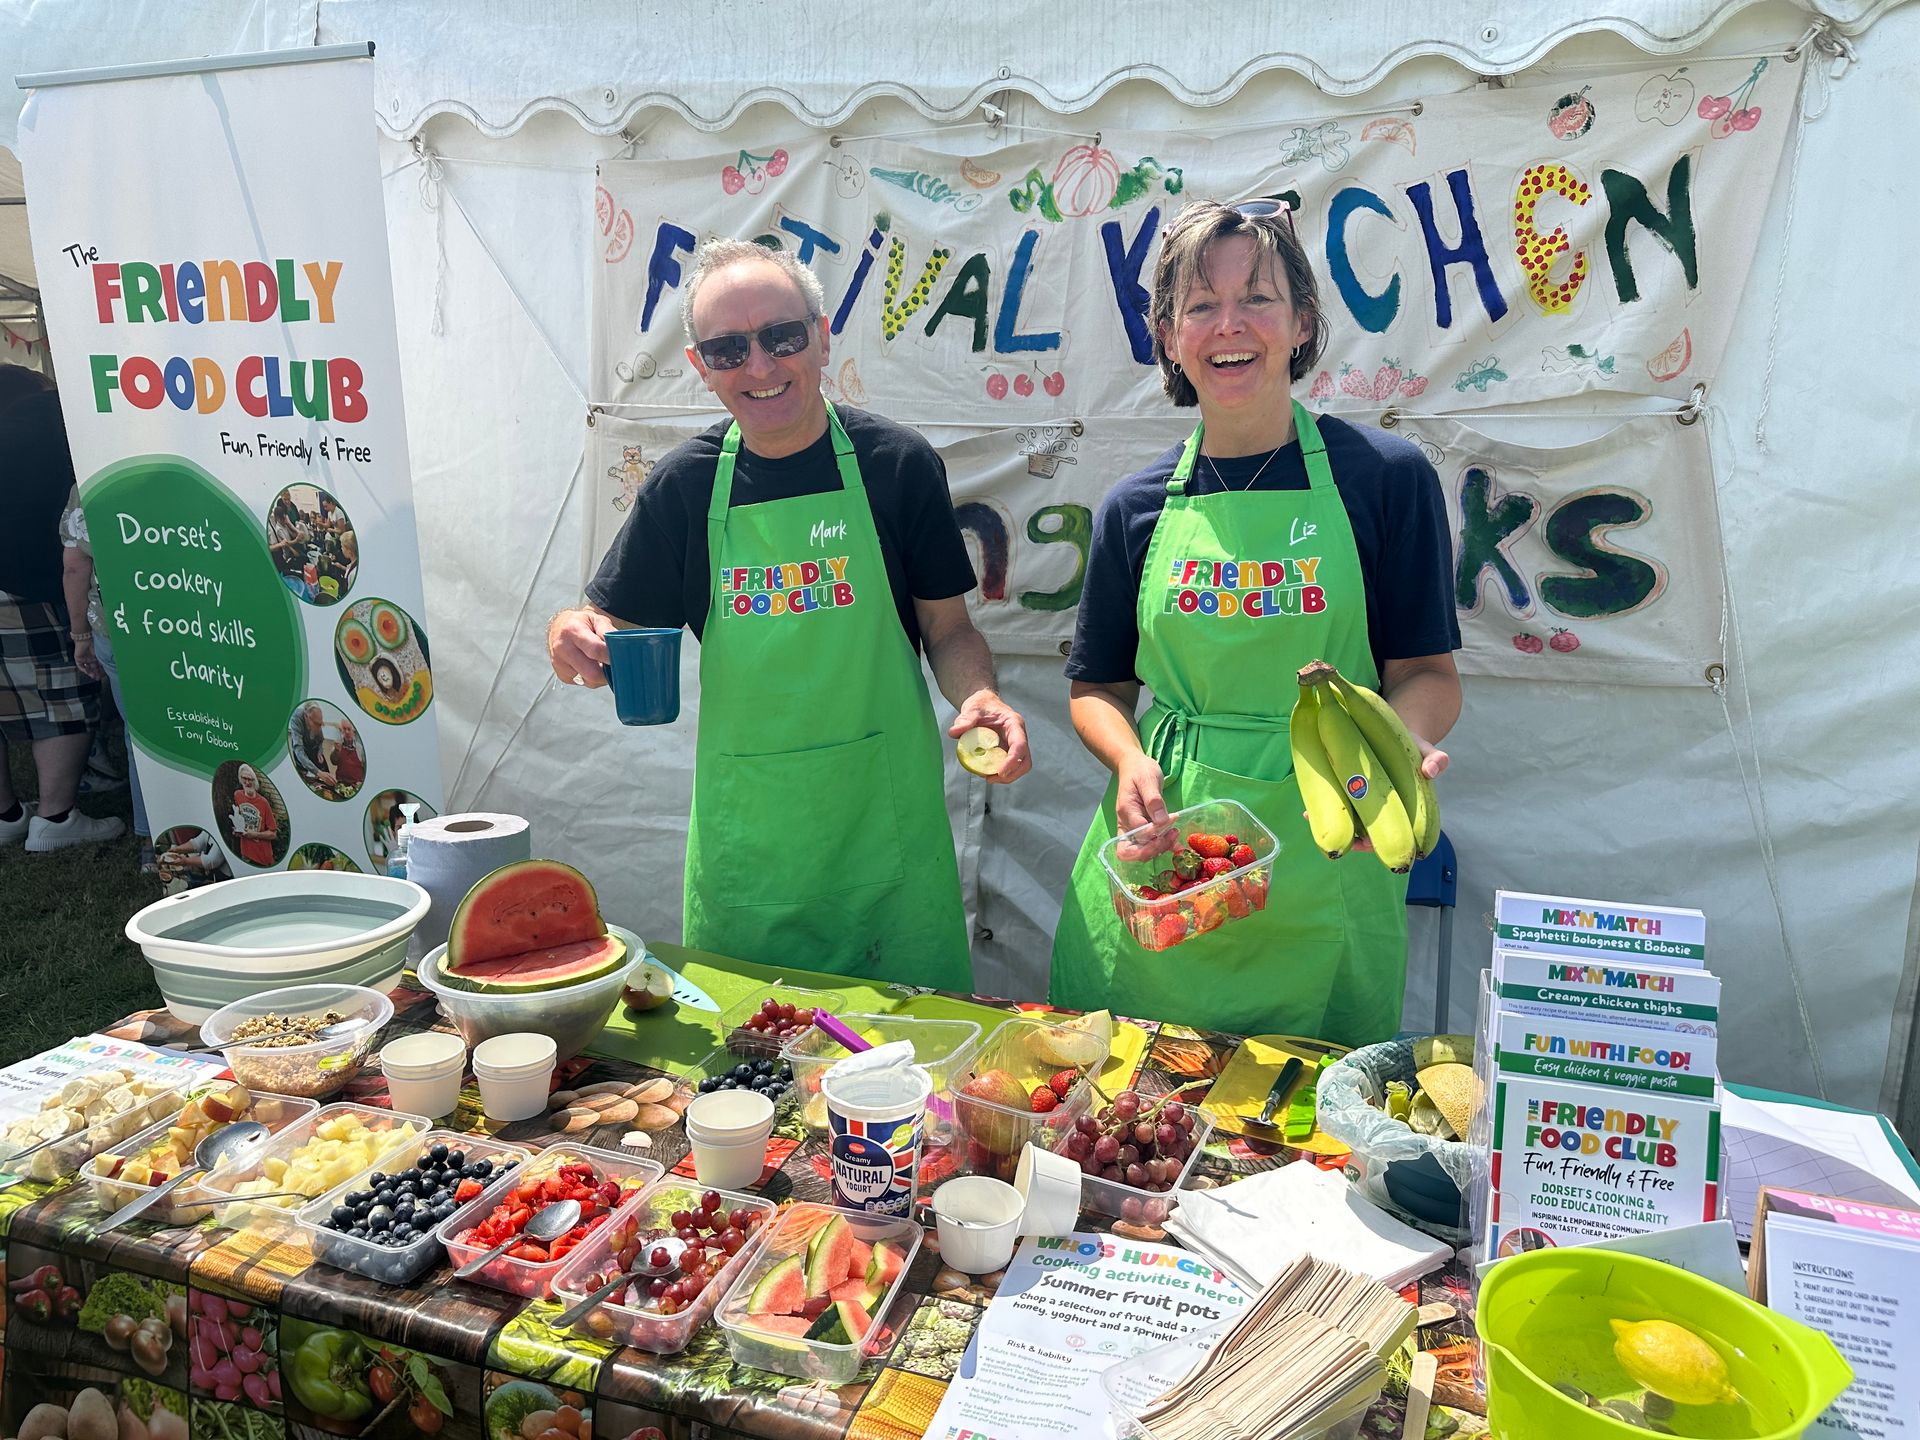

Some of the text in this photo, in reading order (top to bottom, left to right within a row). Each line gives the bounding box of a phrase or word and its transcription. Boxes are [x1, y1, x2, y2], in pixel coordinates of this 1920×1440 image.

[62, 242, 99, 268] The
[1100, 152, 1698, 365] KCHEN
[89, 354, 226, 415] FOOD
[220, 431, 372, 465] Fun, Friendly & Free
[116, 512, 222, 551] Dorset's
[810, 519, 847, 548] Mark
[1289, 517, 1317, 546] Liz
[134, 568, 223, 607] cookery
[721, 568, 731, 593] THE
[1168, 560, 1183, 586] THE
[722, 592, 787, 619] FOOD
[1163, 588, 1239, 617] FOOD
[113, 603, 257, 648] & food skills
[170, 651, 244, 699] charity
[166, 707, 233, 735] Established by
[174, 726, 240, 751] Tony Gibbons
[1512, 927, 1691, 956] Spaghetti bolognese & Bobotie
[1537, 989, 1683, 1016] Creamy chicken thighs
[1569, 1039, 1625, 1062] WITH
[1627, 1045, 1691, 1071] FOOD!
[1534, 1058, 1678, 1089] Easy chicken & veggie pasta
[1527, 1098, 1539, 1122] THE
[1525, 1124, 1600, 1155] FOOD
[835, 1160, 887, 1184] NATURAL
[844, 1152, 871, 1166] Creamy
[845, 1181, 872, 1193] YOGURT
[1559, 1157, 1622, 1189] Friendly
[1626, 1170, 1635, 1188] &
[1638, 1169, 1675, 1192] Free
[1530, 1194, 1669, 1226] FOOD EDUCATION CHARITY
[1542, 1182, 1655, 1210] DORSET'S COOKING &
[1808, 1196, 1891, 1220] Please
[1531, 1211, 1562, 1222] INSPIRING
[1569, 1217, 1611, 1230] EMPOWERING
[1539, 1221, 1557, 1230] COOK
[1581, 1228, 1602, 1237] CHEAP
[1037, 1236, 1239, 1289] WHO'S HUNGRY
[1031, 1254, 1244, 1307] Cooking activities here!
[1040, 1274, 1221, 1321] Summer Fruit pots
[1019, 1292, 1047, 1306] Chop
[1058, 1299, 1107, 1318] selection
[1109, 1308, 1123, 1319] of
[1156, 1320, 1178, 1332] add
[1180, 1324, 1188, 1333] a
[1051, 1308, 1098, 1328] yoghurt
[1099, 1320, 1122, 1333] and
[1123, 1325, 1131, 1333] a
[1007, 1339, 1026, 1350] Risk
[1037, 1348, 1073, 1364] liability
